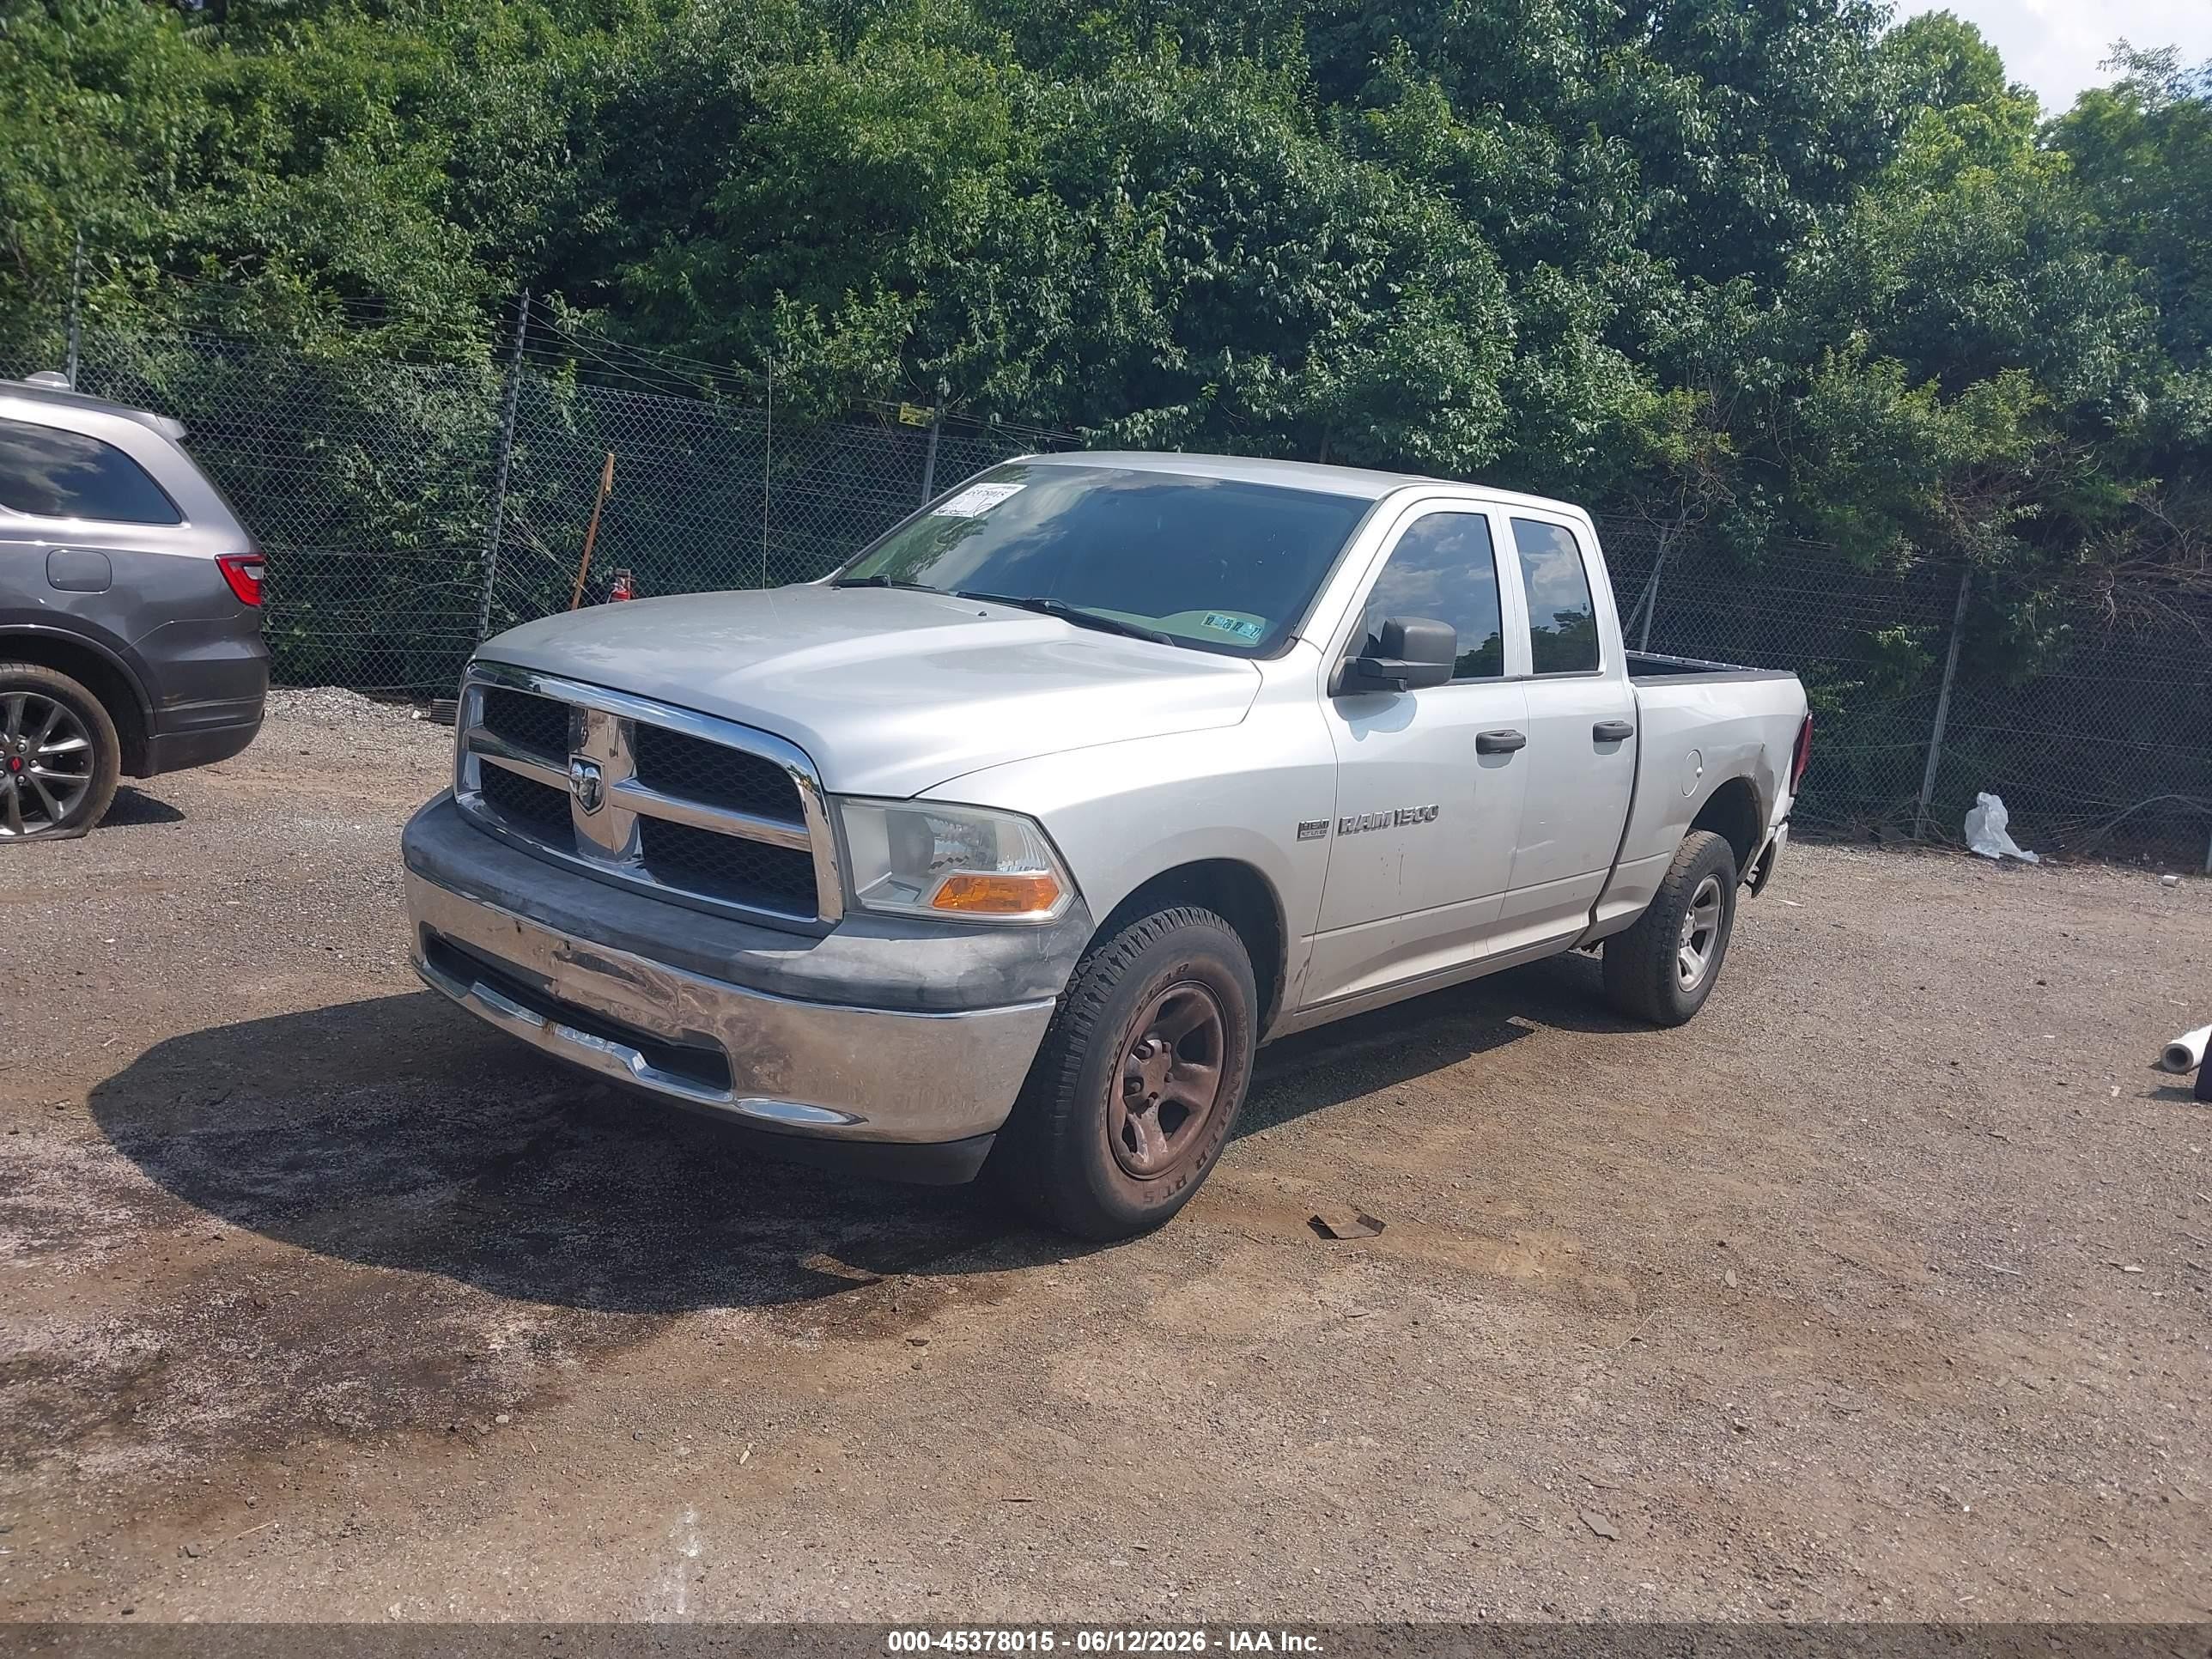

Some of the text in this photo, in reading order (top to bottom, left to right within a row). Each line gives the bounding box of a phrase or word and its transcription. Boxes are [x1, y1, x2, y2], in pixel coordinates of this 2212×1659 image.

[1298, 819, 1330, 831] HEMI
[1337, 804, 1440, 836] RAM 1500
